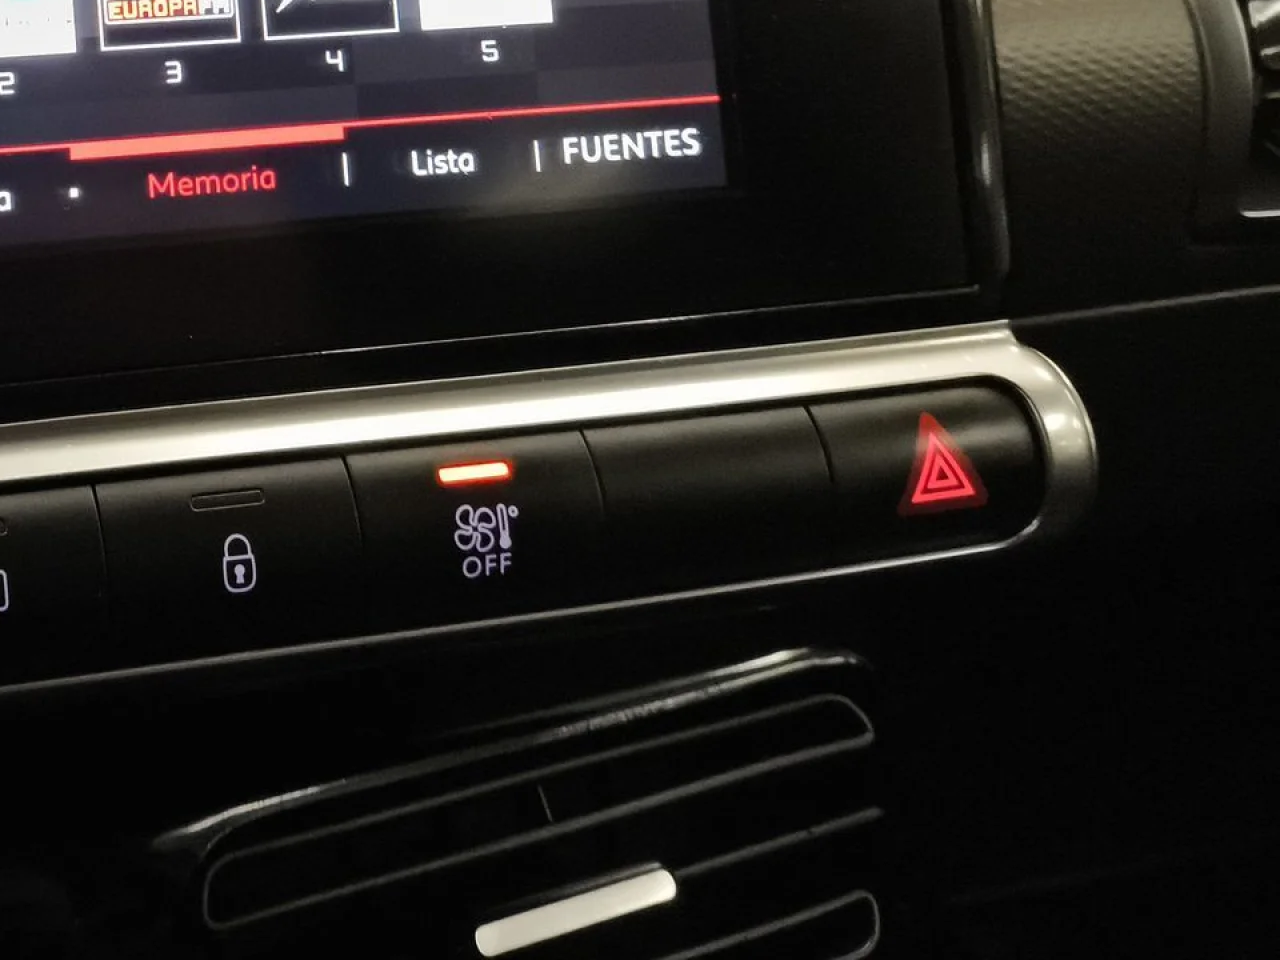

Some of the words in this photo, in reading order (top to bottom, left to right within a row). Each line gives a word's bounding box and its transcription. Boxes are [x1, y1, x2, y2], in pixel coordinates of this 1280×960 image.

[325, 49, 345, 73] 4
[480, 39, 501, 63] 5
[164, 60, 184, 85] 3
[562, 127, 702, 166] FUENTES
[411, 148, 476, 178] Lista
[147, 165, 277, 199] Memoria
[462, 551, 512, 579] OFF
